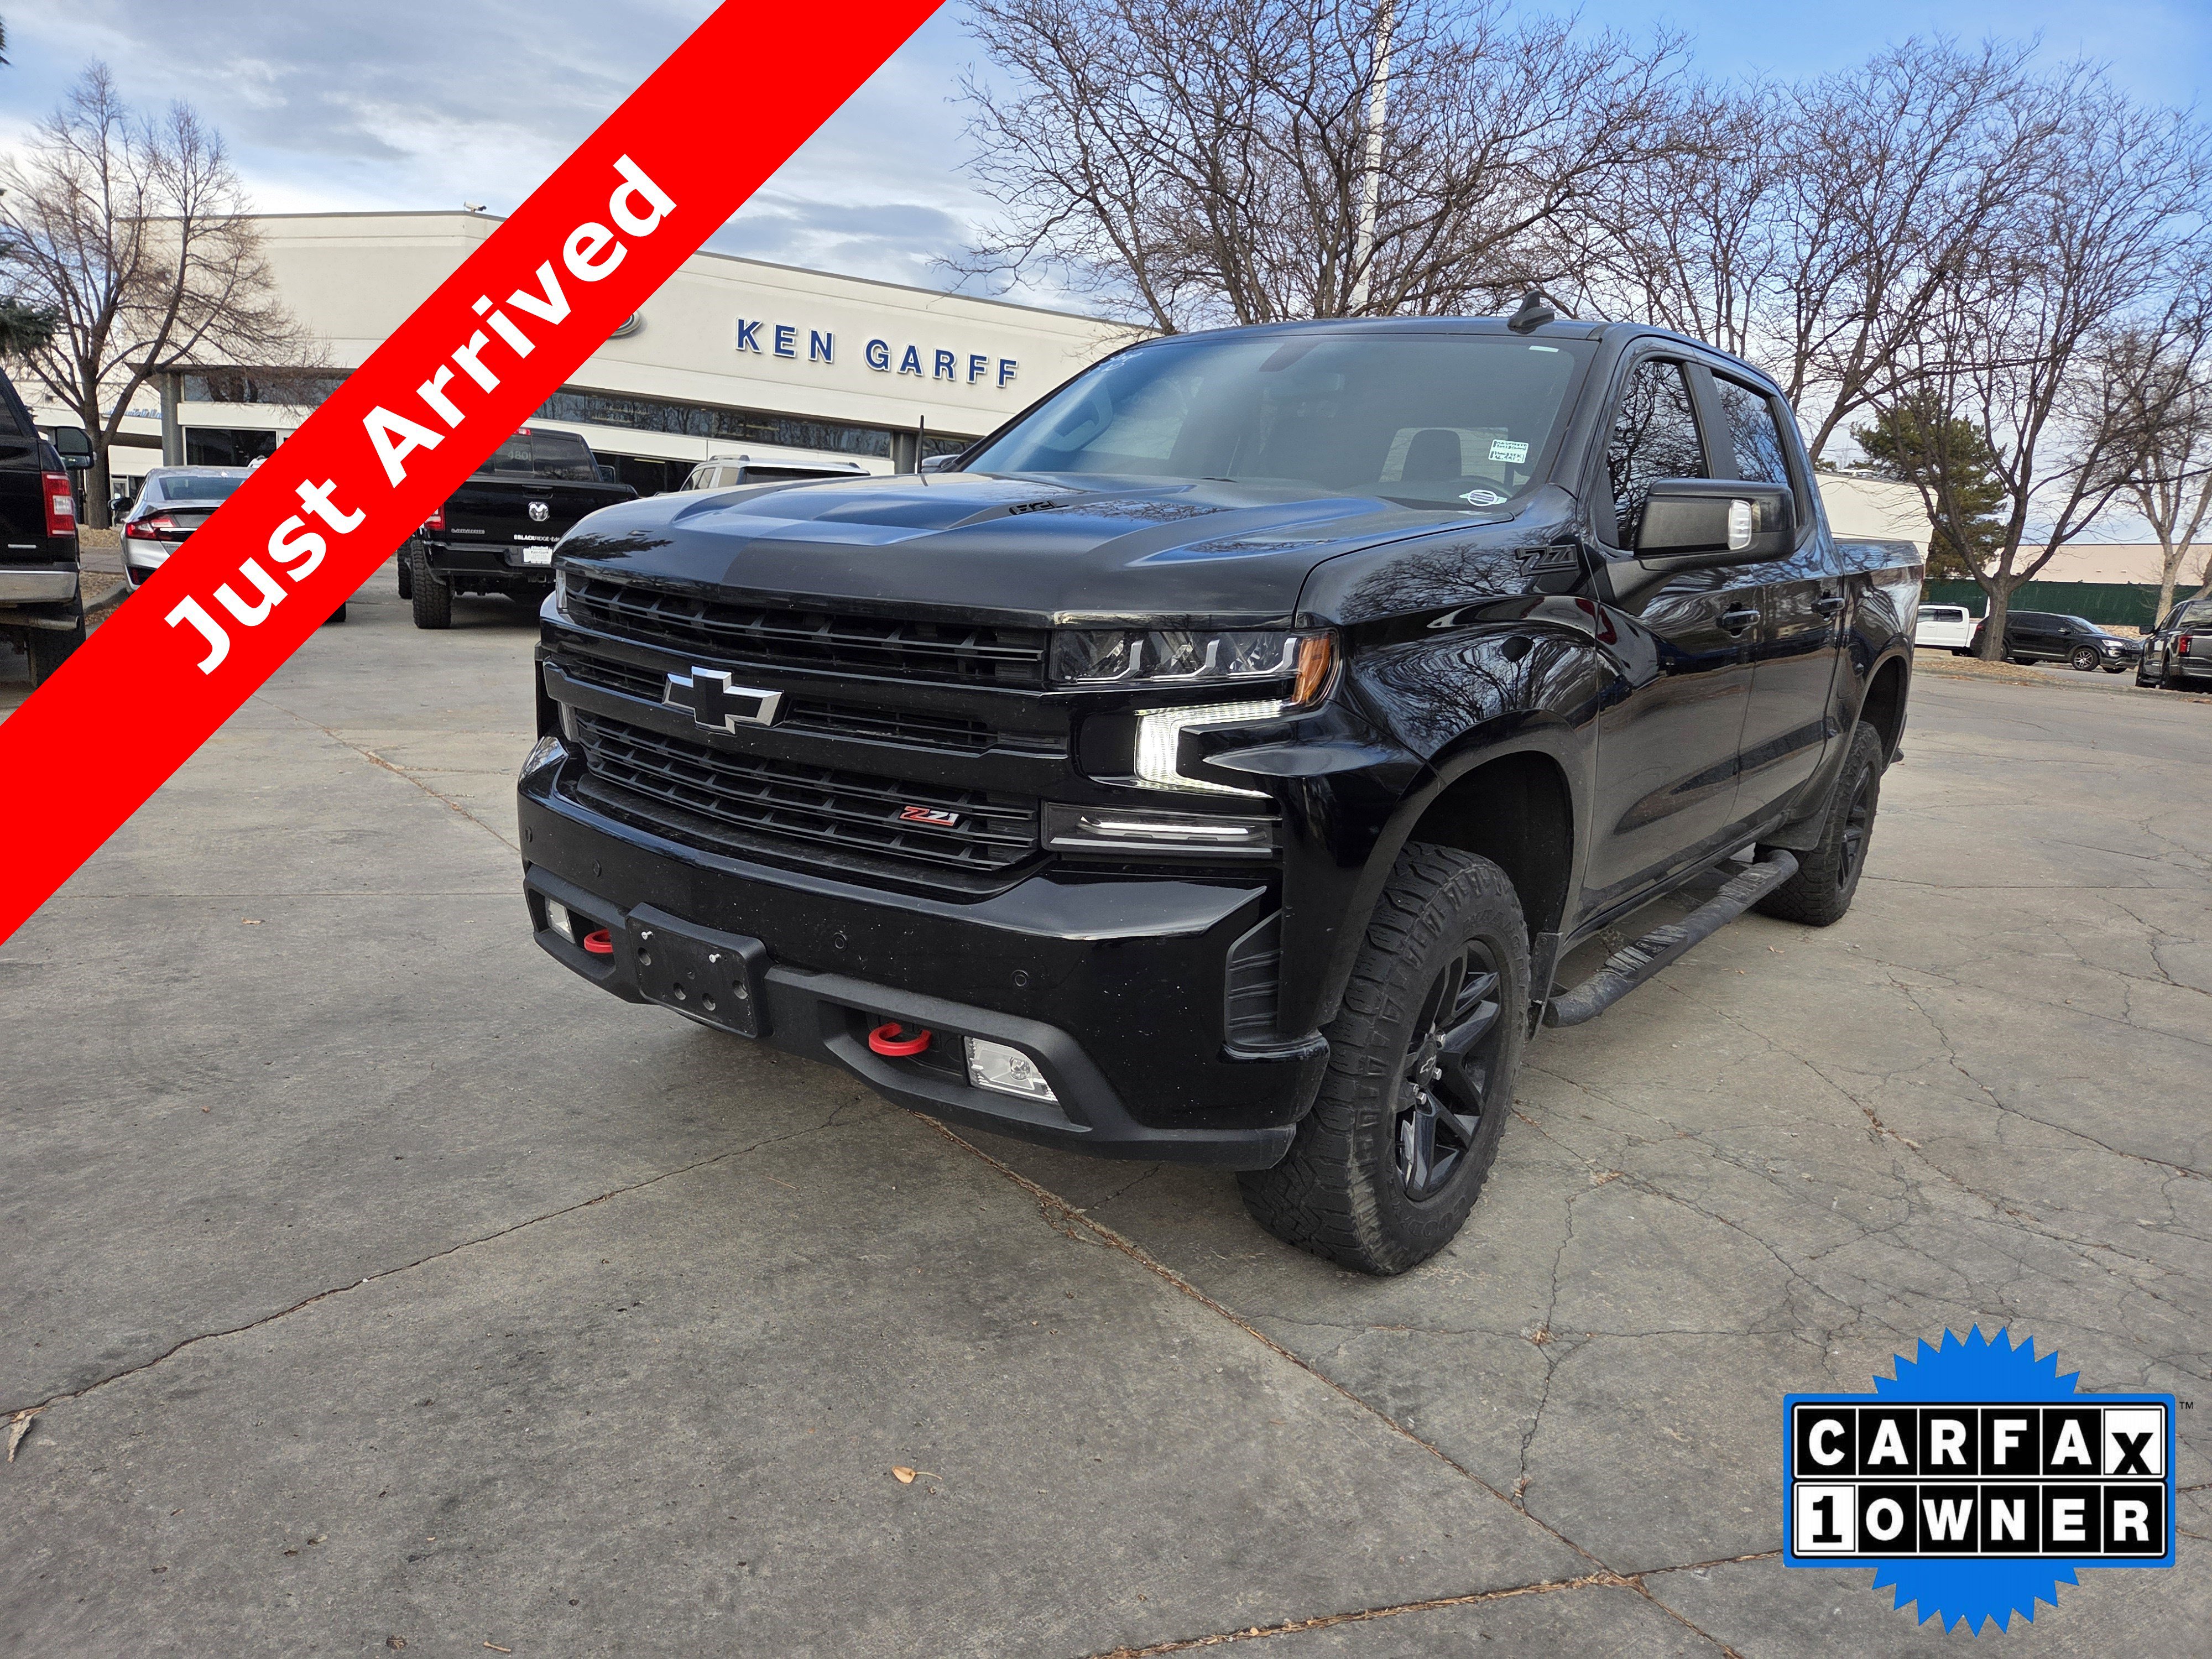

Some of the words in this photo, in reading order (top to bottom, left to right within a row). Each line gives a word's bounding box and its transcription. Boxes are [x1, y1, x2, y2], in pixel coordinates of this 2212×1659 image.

[736, 317, 834, 363] KEN
[864, 338, 1018, 388] GARFF
[1515, 544, 1579, 577] Z71
[899, 806, 959, 826] Z71
